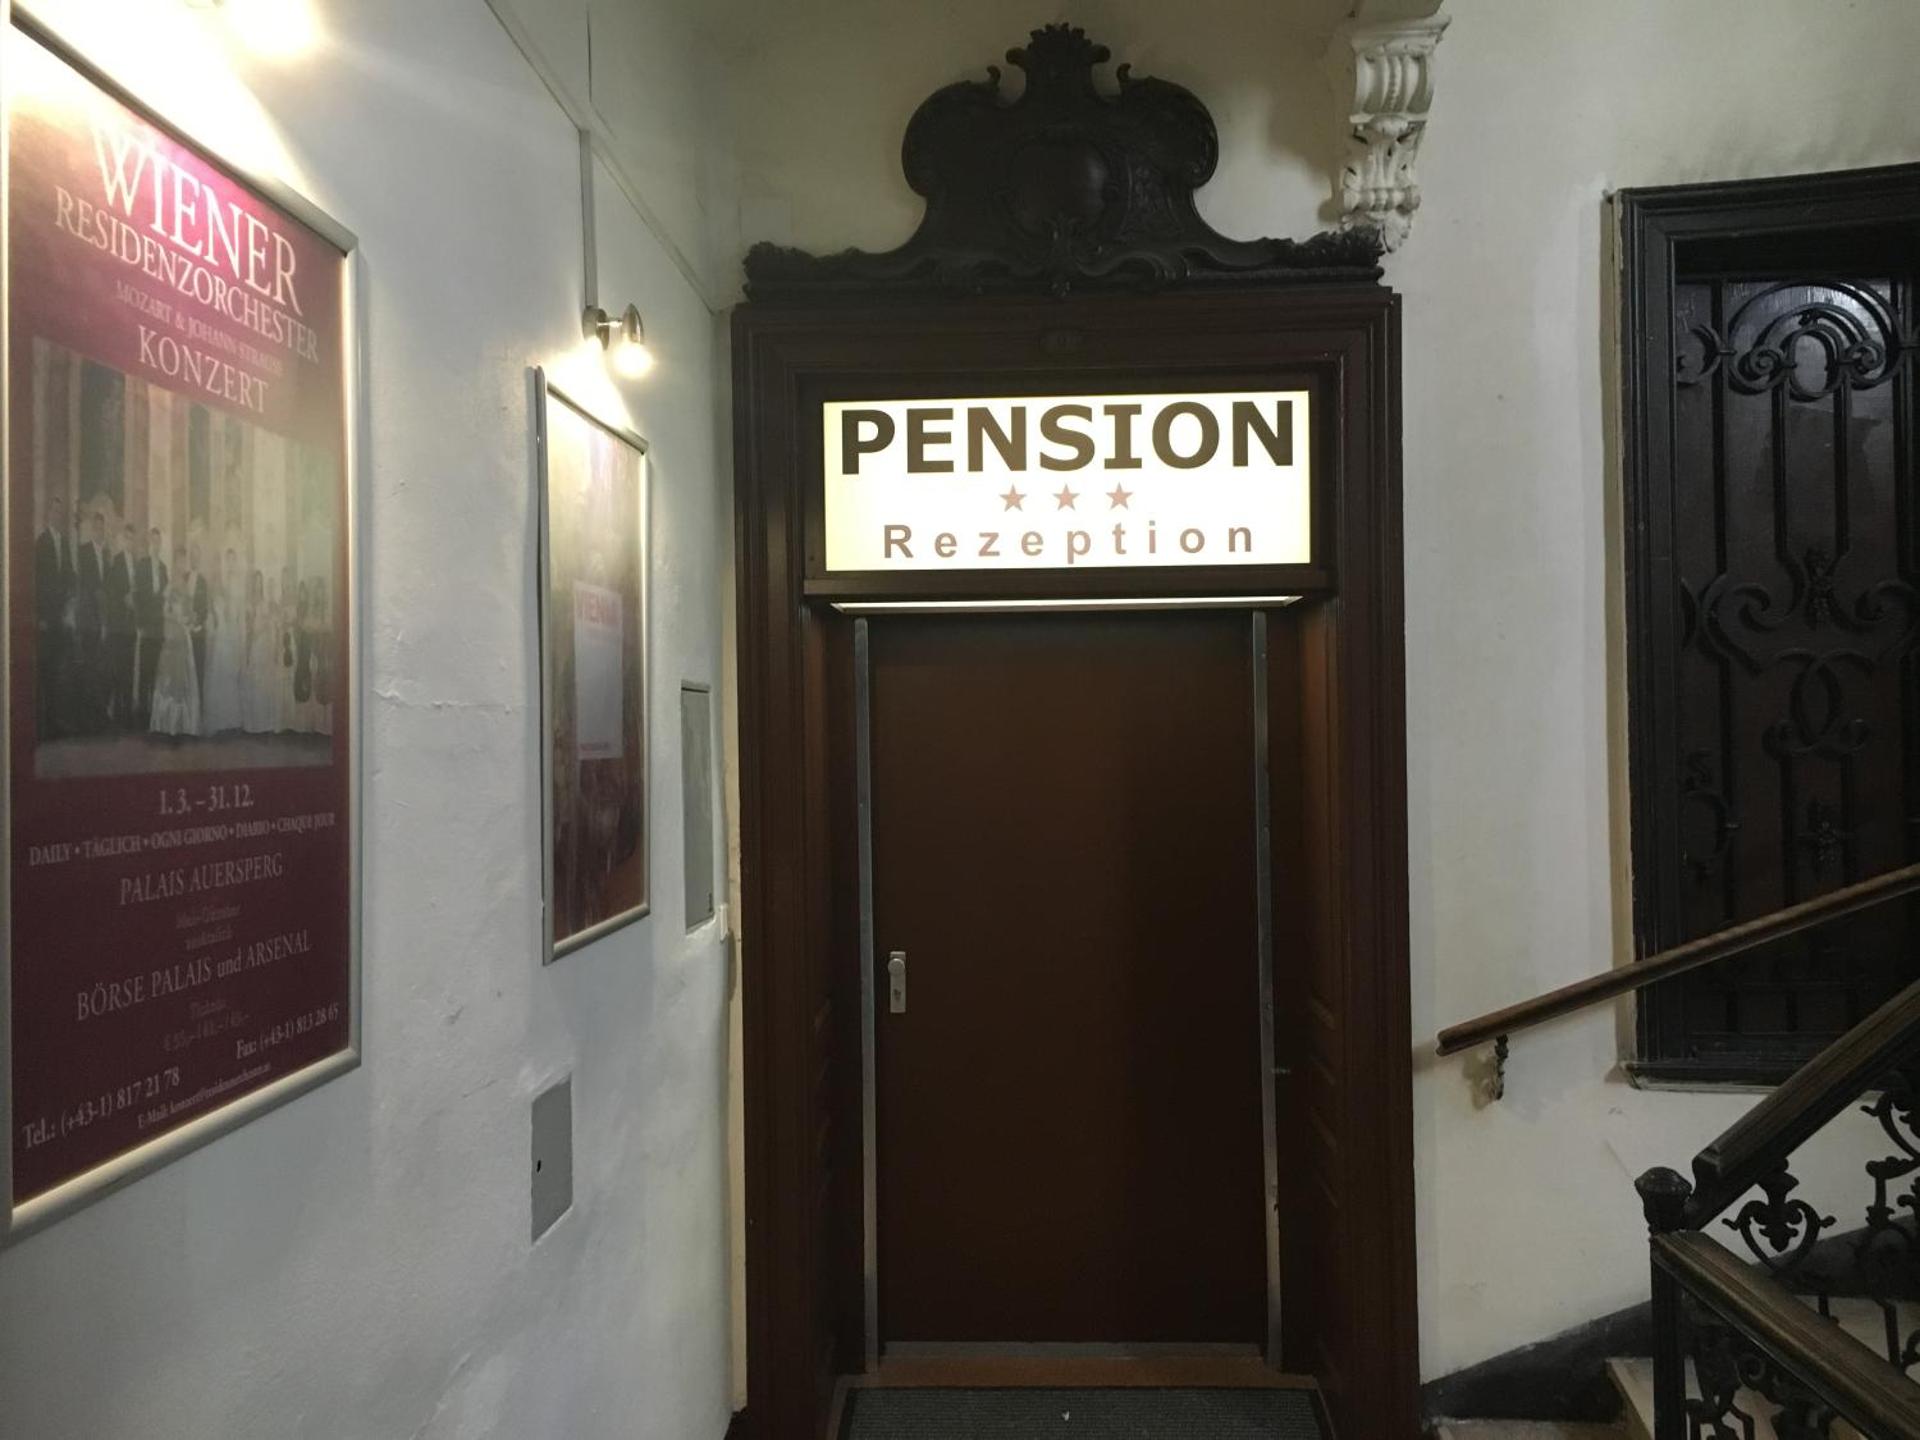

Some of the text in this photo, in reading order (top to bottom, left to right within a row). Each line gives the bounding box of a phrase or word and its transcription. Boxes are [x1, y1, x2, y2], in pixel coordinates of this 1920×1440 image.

[90, 126, 303, 317] WIENER
[55, 185, 320, 364] RESIDENZORCHESTER
[116, 279, 174, 324] MOZART
[187, 316, 237, 355] JOHANN
[138, 324, 269, 414] KONZERT
[841, 400, 1293, 475] PENSION
[883, 520, 1253, 564] Rezeption
[29, 844, 73, 866] DAILY
[150, 830, 182, 850] OGNI
[183, 823, 229, 845] GIORNO
[119, 852, 284, 906] PALAIS AUERSPERG
[76, 980, 147, 1022] BÖRSE
[150, 957, 213, 998] PALAIS
[216, 948, 243, 978] und
[244, 928, 312, 969] ARSENAL
[60, 1095, 113, 1137] (+43-1)
[116, 1081, 142, 1111] 817
[145, 1076, 161, 1098] 21
[162, 1065, 180, 1089] 78
